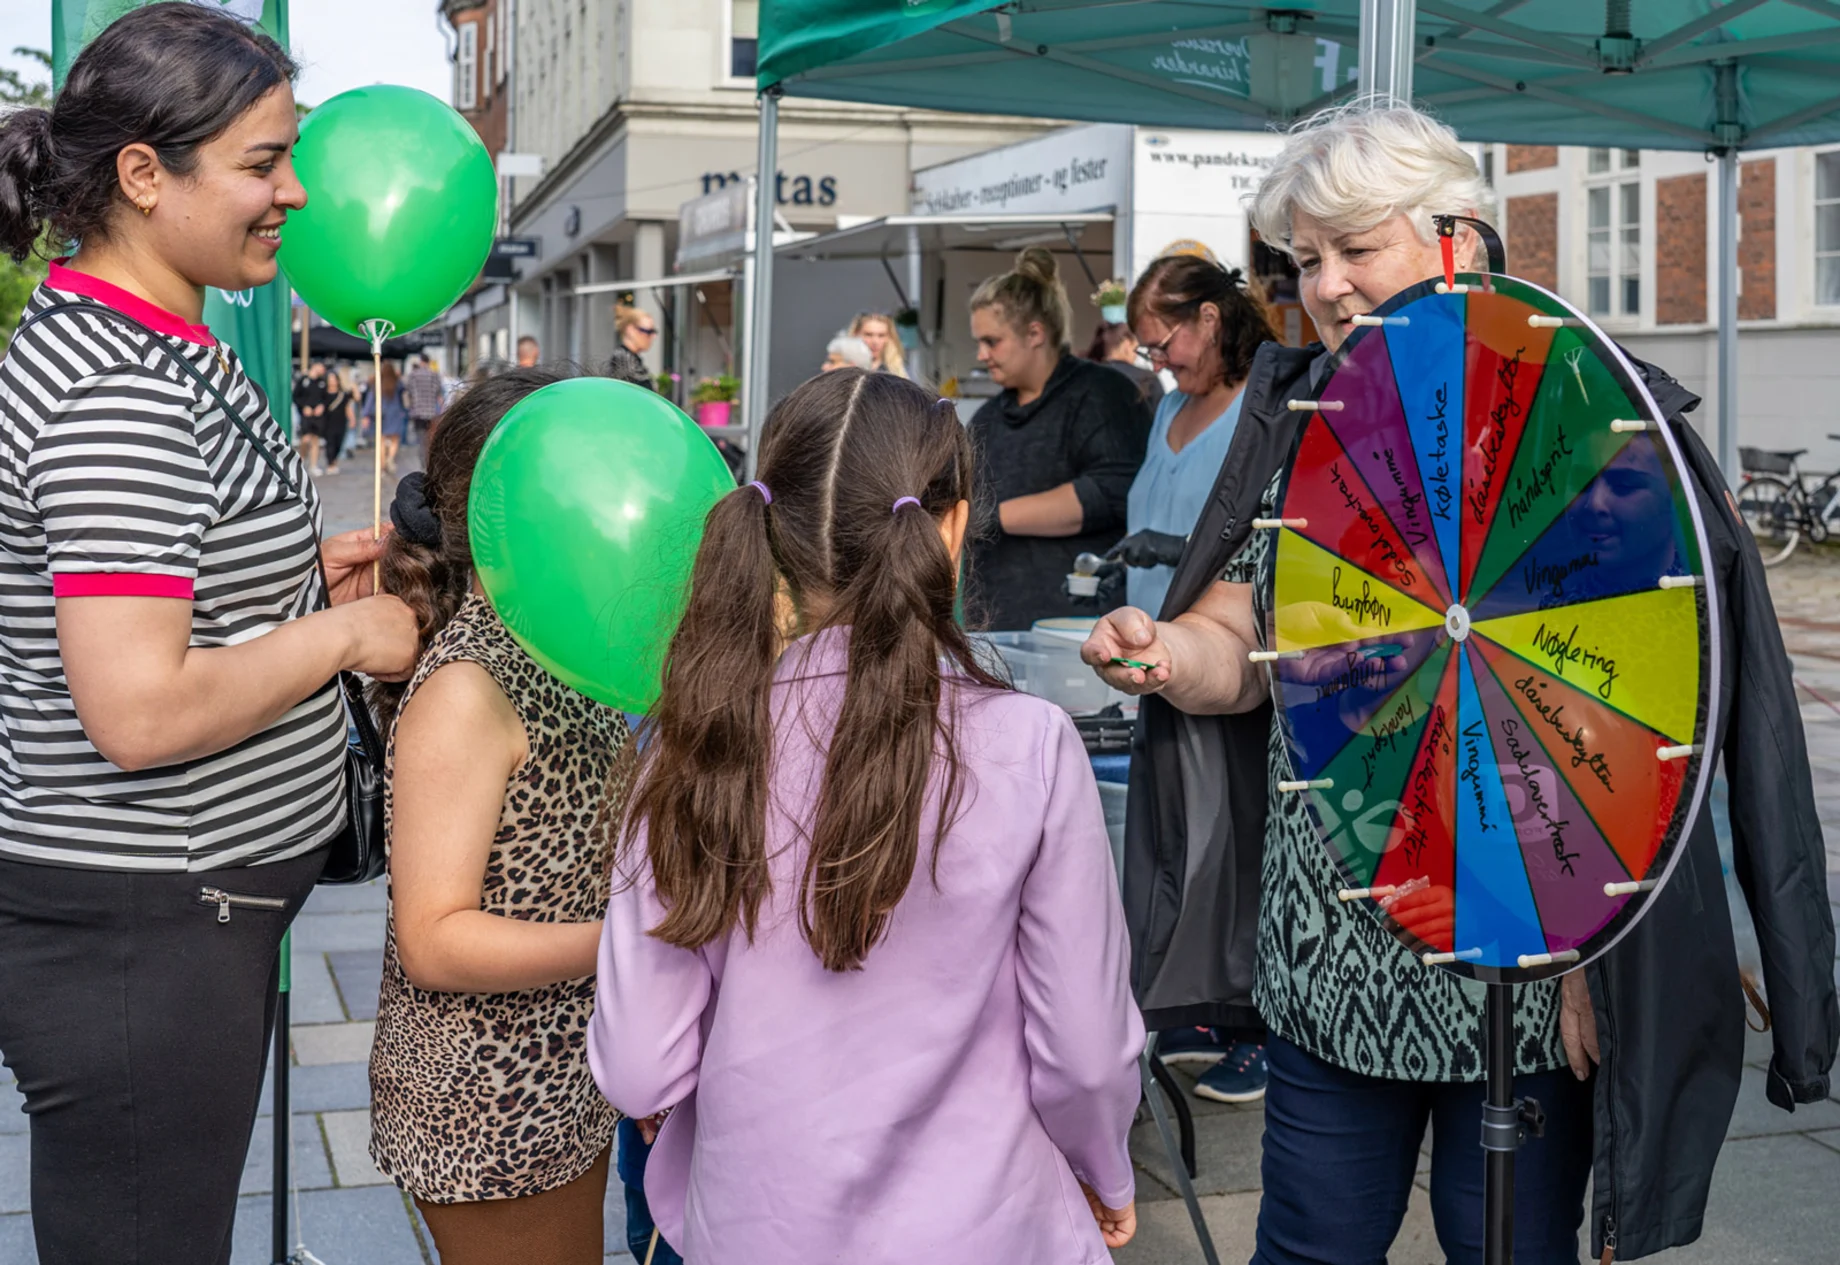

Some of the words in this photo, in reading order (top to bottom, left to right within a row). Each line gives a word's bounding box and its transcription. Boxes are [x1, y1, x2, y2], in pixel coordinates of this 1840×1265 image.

[1507, 424, 1573, 528] håndsprit
[1533, 623, 1619, 699] Nøglering
[1461, 720, 1498, 833] Vingummi
